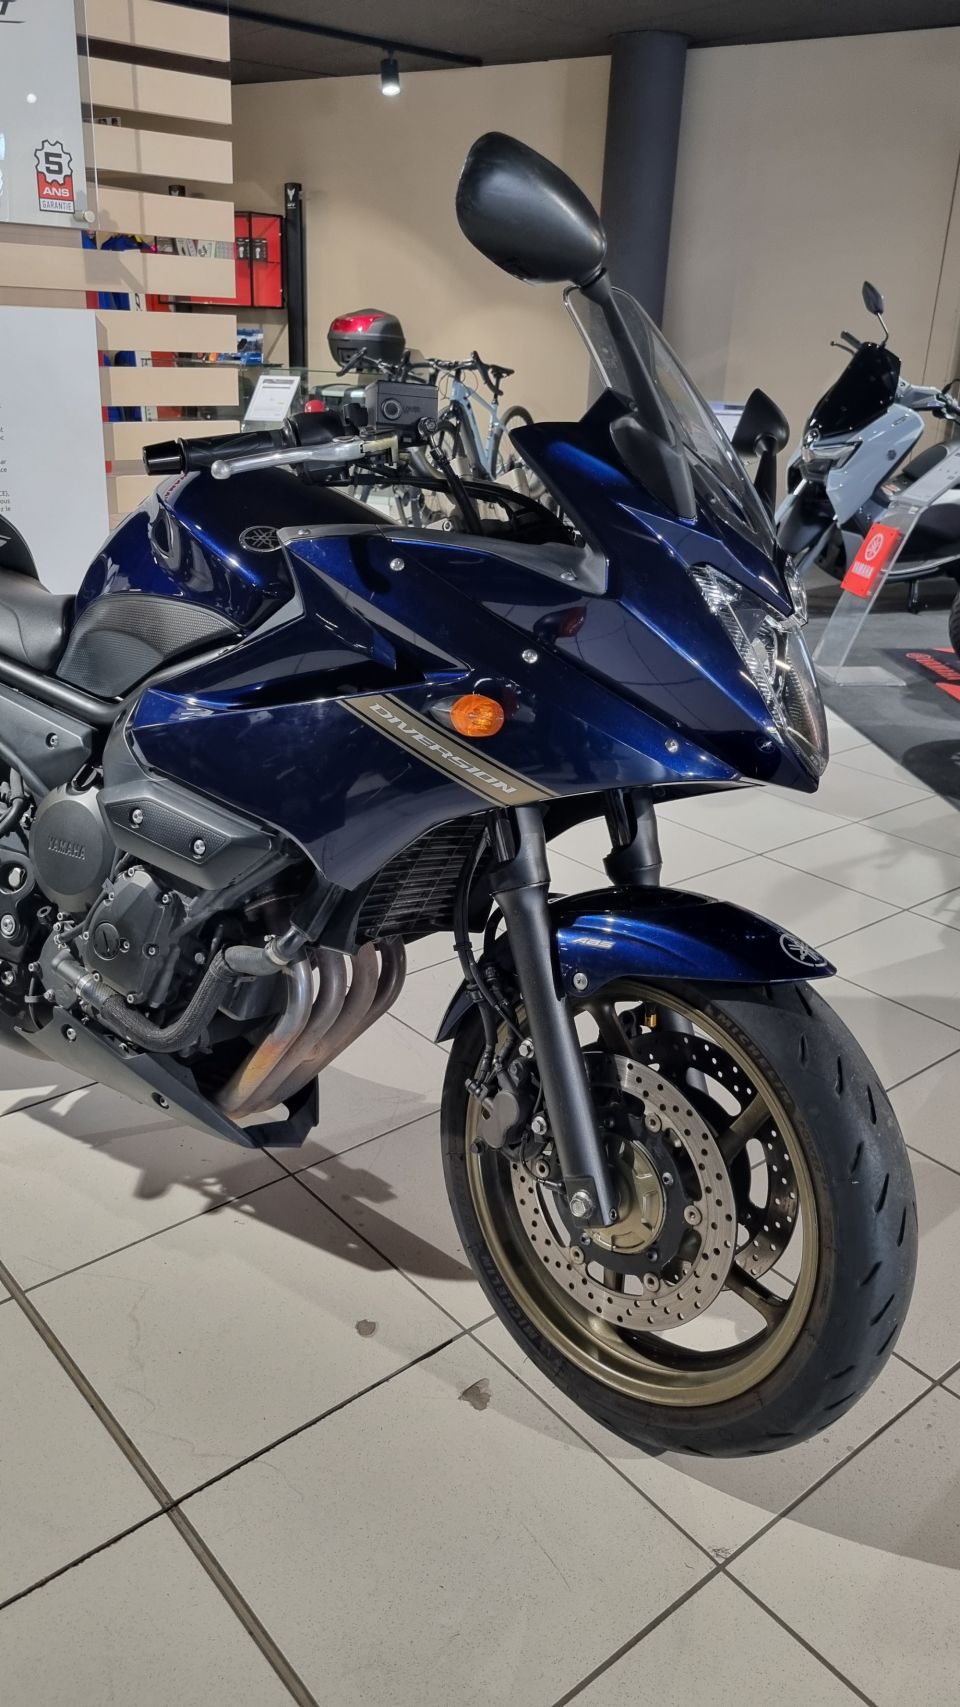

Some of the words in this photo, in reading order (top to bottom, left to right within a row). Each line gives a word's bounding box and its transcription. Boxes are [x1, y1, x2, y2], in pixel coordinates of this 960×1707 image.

[44, 151, 63, 175] 5
[43, 186, 70, 197] ANS
[42, 200, 72, 211] GARANTIE
[369, 703, 517, 794] DIVERSION
[48, 834, 86, 860] YAMAHA
